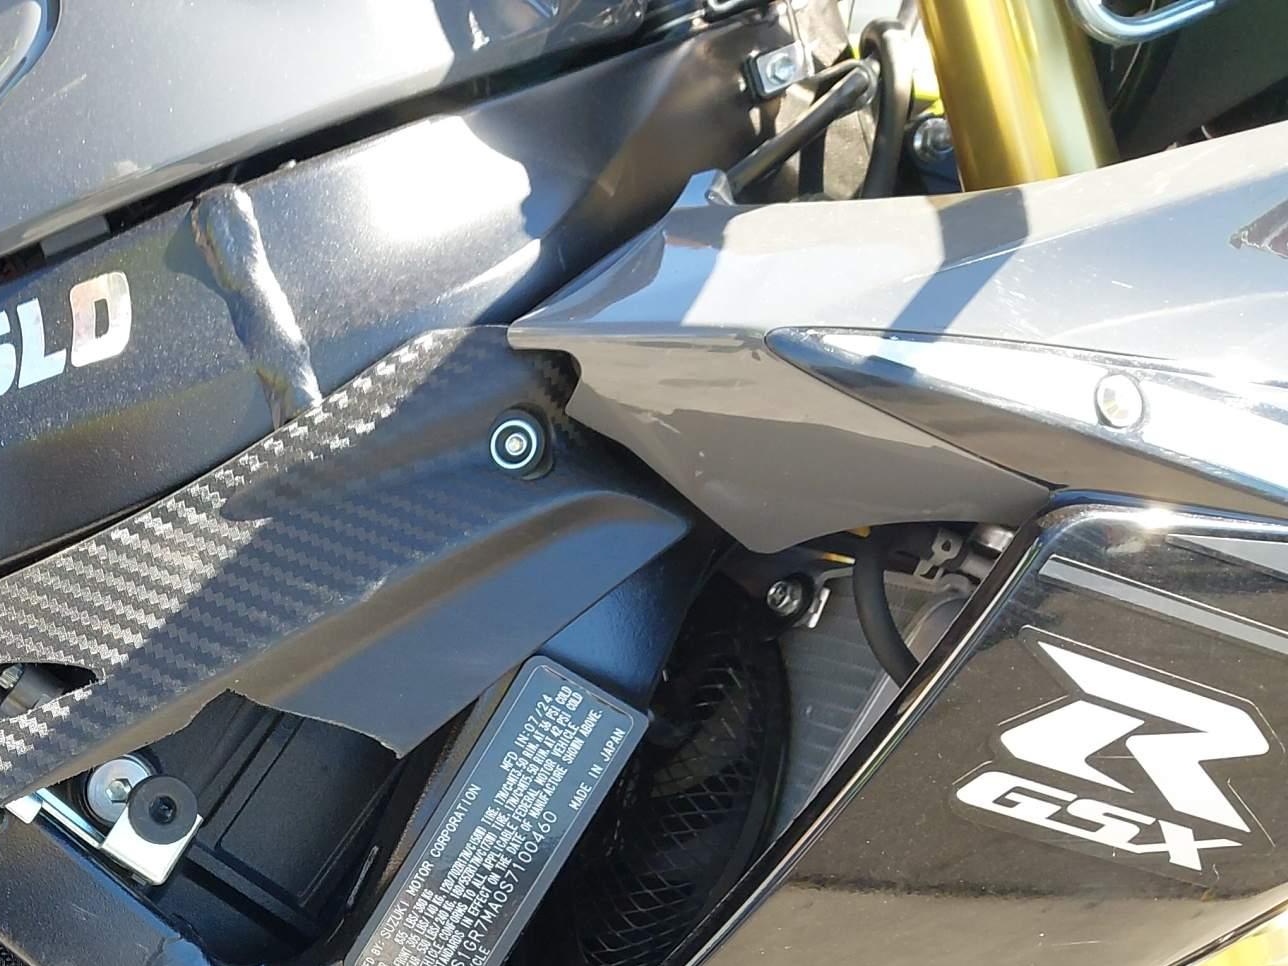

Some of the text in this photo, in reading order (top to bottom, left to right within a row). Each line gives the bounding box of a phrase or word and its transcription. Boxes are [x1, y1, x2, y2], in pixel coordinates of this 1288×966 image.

[554, 684, 573, 706] COLD
[545, 703, 561, 721] PSI
[531, 729, 546, 742] AT
[538, 718, 552, 732] 36
[499, 749, 519, 772] MFD
[568, 726, 626, 811] MADE IN JAPAN
[415, 938, 432, 954] 530
[542, 735, 556, 749] AT
[549, 724, 563, 738] 42
[556, 710, 572, 727] PSI
[565, 690, 584, 712] COLD
[459, 915, 474, 928] IN
[467, 884, 493, 917] EFFECT
[486, 871, 501, 885] ON
[494, 853, 512, 872] THE
[505, 831, 526, 855] DATE
[519, 818, 534, 832] OF
[527, 763, 568, 819] MANUFACTURE
[561, 735, 585, 765] SHOWN
[578, 705, 604, 737] ABOVE.
[956, 771, 1243, 872] GSX
[437, 900, 468, 941] CONFORMS
[462, 888, 476, 901] TO
[470, 870, 487, 888] ALL
[481, 820, 518, 871] APPLICABLE
[511, 785, 540, 822] FEDERAL
[533, 756, 557, 786] MOTOR
[550, 721, 579, 759] VEHICLE
[378, 899, 410, 939] SUZUKI
[405, 859, 434, 896] MOTOR
[428, 782, 481, 858] CORPORATION
[420, 887, 435, 900] KG
[404, 932, 421, 949] 305
